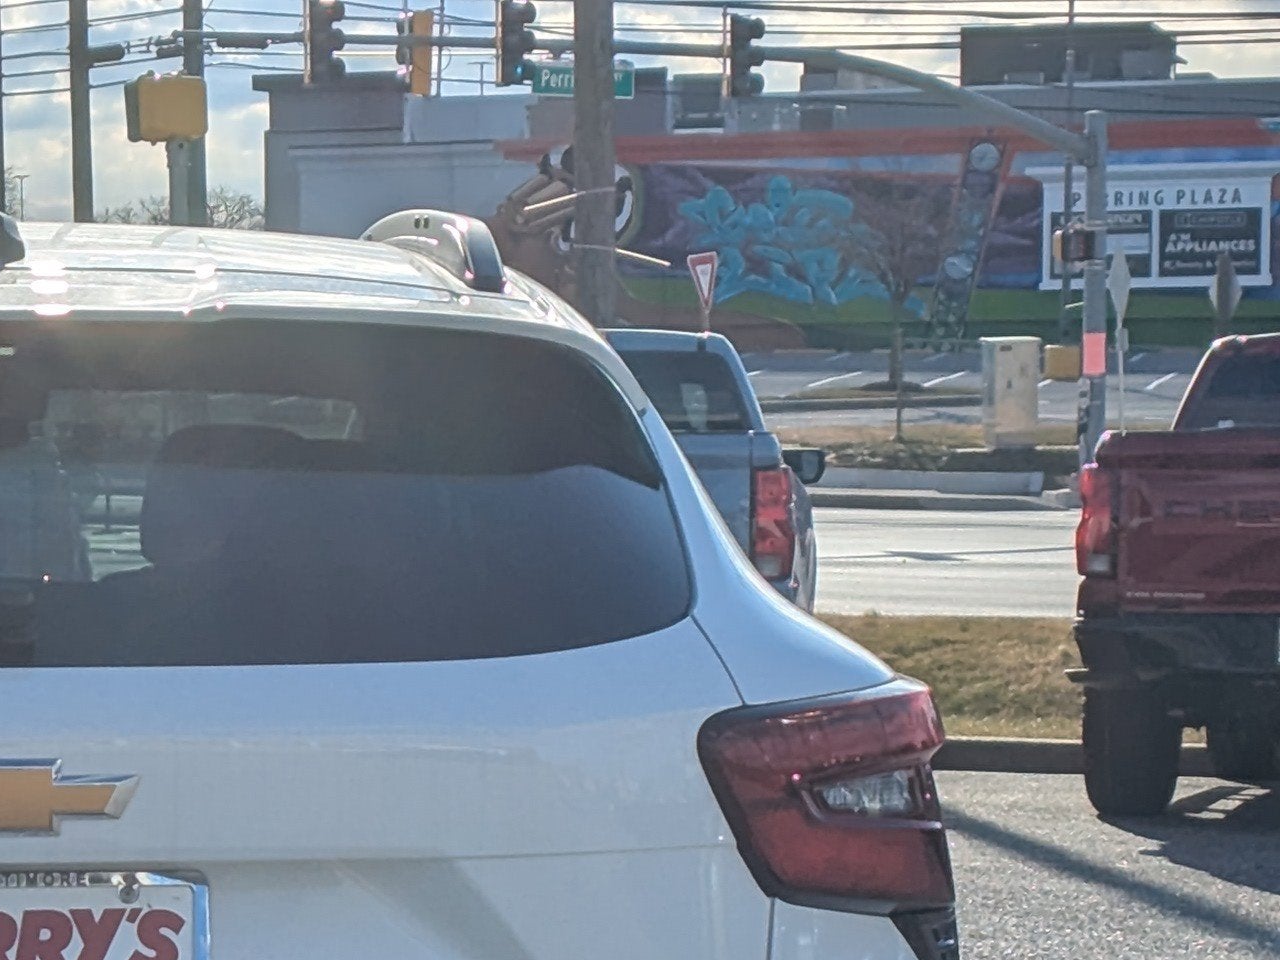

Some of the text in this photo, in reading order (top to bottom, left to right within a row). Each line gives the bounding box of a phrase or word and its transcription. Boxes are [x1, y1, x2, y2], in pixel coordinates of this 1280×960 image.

[540, 69, 575, 88] Perri
[1070, 187, 1243, 207] PRING PLAZA
[1165, 239, 1256, 253] APPLIANCES
